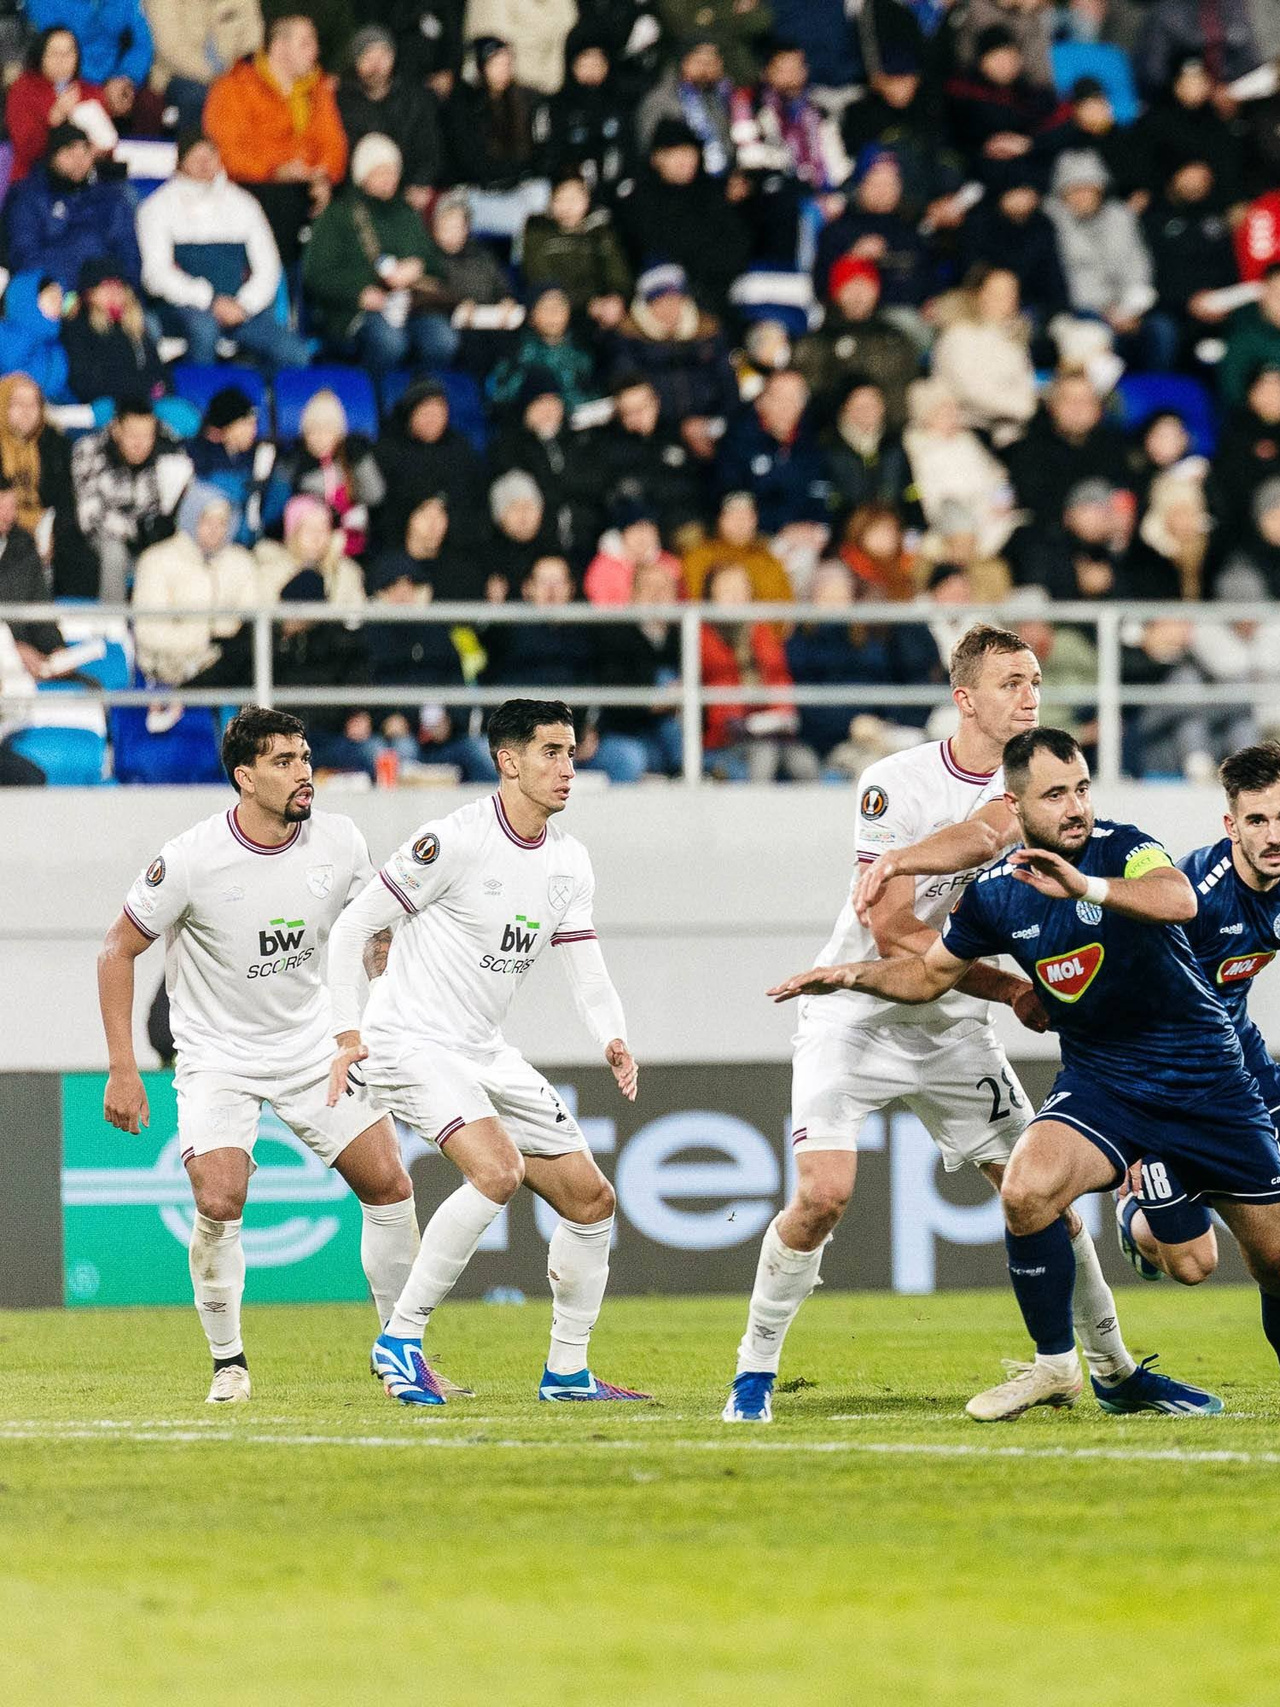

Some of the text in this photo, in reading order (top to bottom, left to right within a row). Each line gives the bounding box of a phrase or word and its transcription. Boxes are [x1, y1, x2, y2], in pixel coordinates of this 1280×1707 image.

[258, 929, 305, 956] bw
[500, 923, 538, 953] bw
[1046, 957, 1084, 983] MOL
[1224, 958, 1258, 976] MOL
[1142, 1161, 1173, 1200] 18
